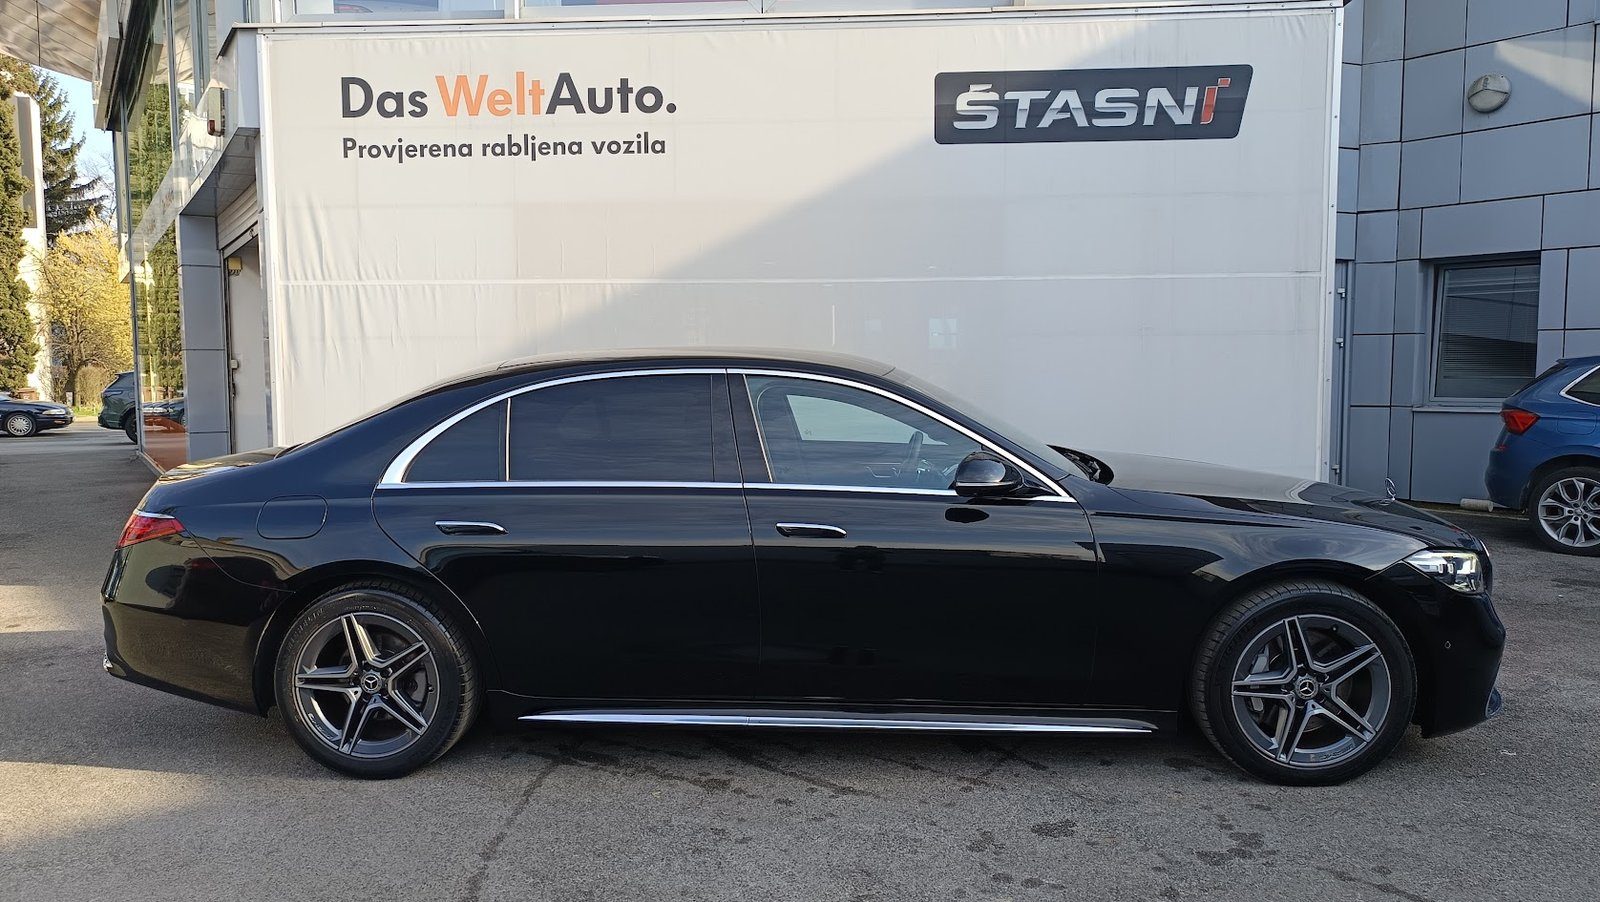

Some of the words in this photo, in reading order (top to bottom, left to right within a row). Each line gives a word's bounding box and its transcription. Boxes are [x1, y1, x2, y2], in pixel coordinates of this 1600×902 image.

[341, 76, 428, 119] Das
[343, 137, 473, 163] Provjerena
[483, 134, 582, 162] rabljena
[592, 132, 666, 155] vozila
